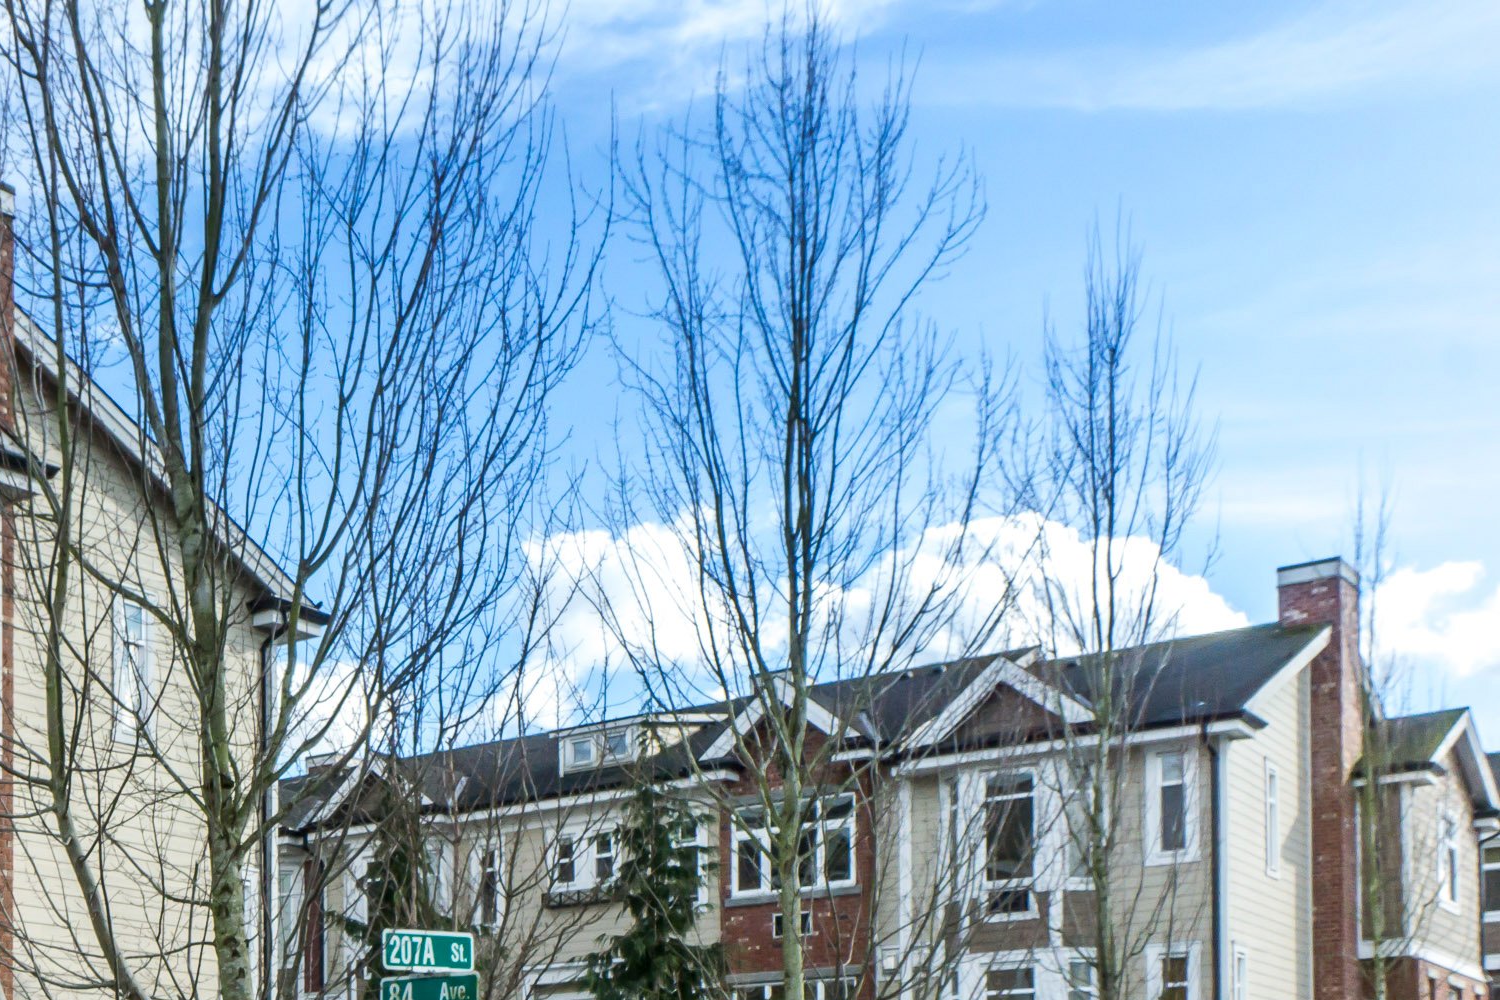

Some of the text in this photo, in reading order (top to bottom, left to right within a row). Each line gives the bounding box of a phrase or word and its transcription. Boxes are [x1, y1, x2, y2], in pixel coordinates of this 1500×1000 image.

[389, 935, 468, 965] 207A St.
[439, 981, 471, 1000] Ave.
